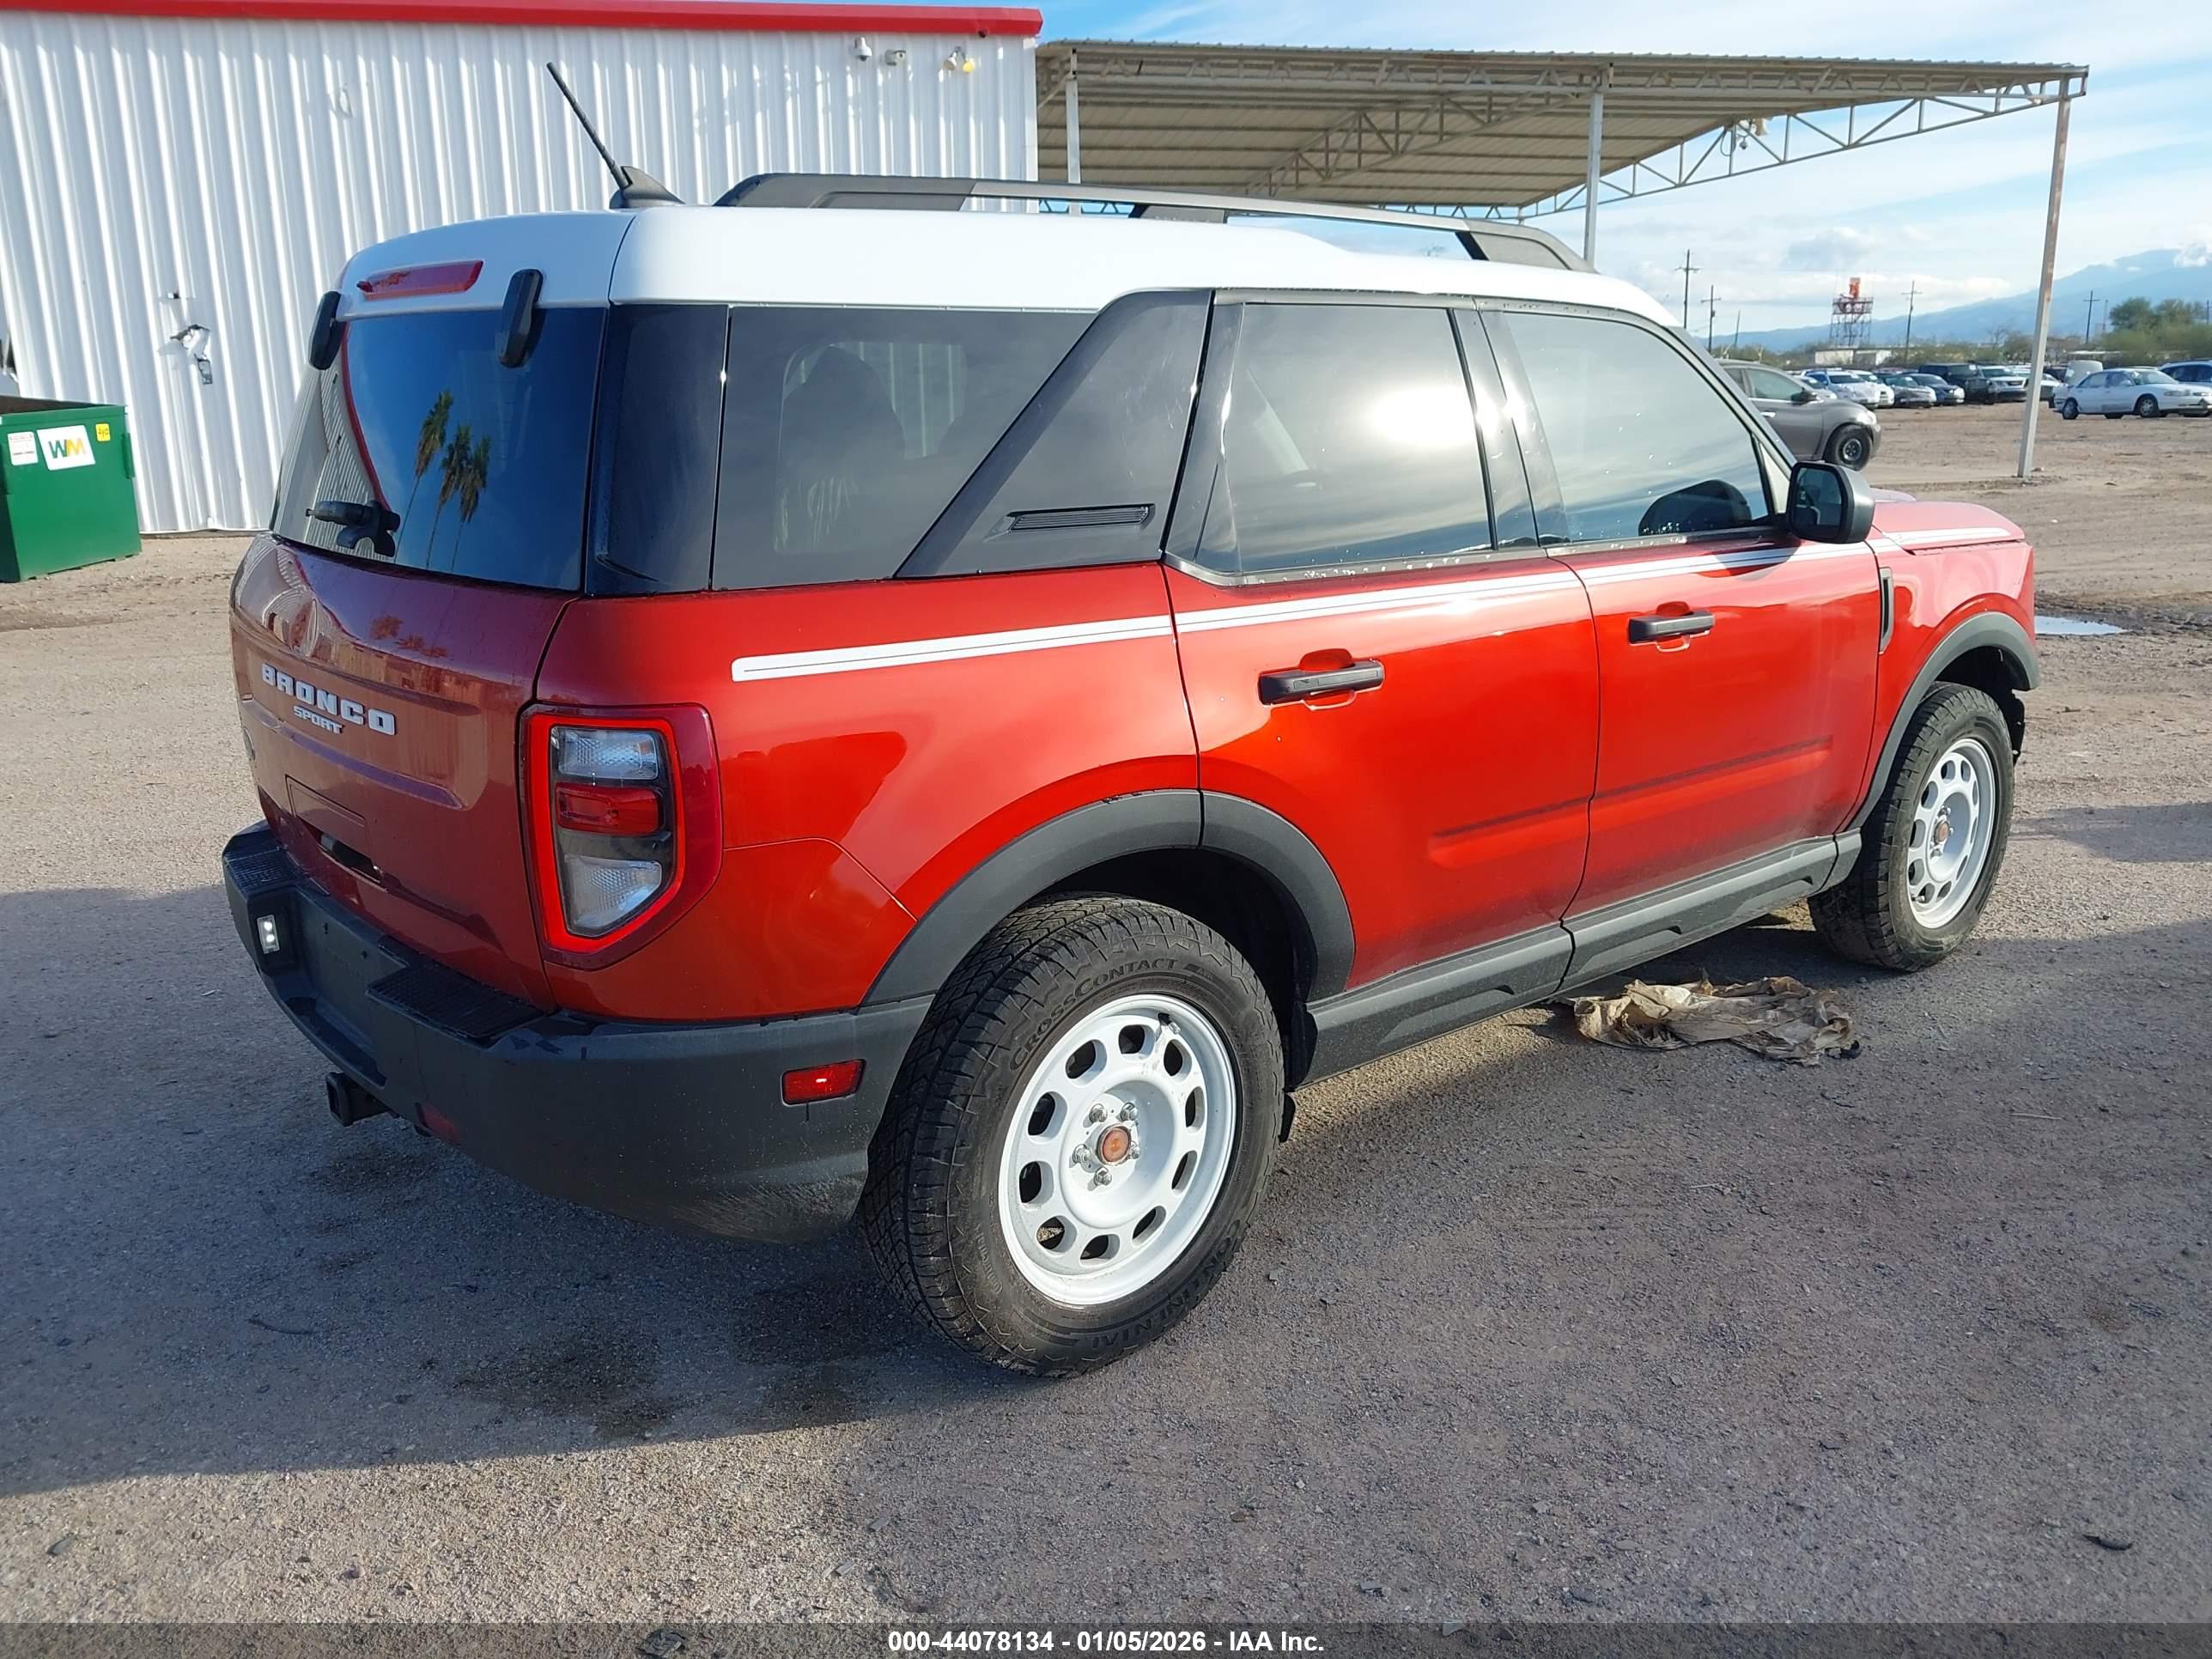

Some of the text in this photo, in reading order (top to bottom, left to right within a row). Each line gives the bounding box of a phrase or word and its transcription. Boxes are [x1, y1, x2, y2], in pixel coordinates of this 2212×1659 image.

[48, 437, 86, 459] WM
[261, 663, 397, 736] BRONCO
[294, 705, 344, 734] SPORT
